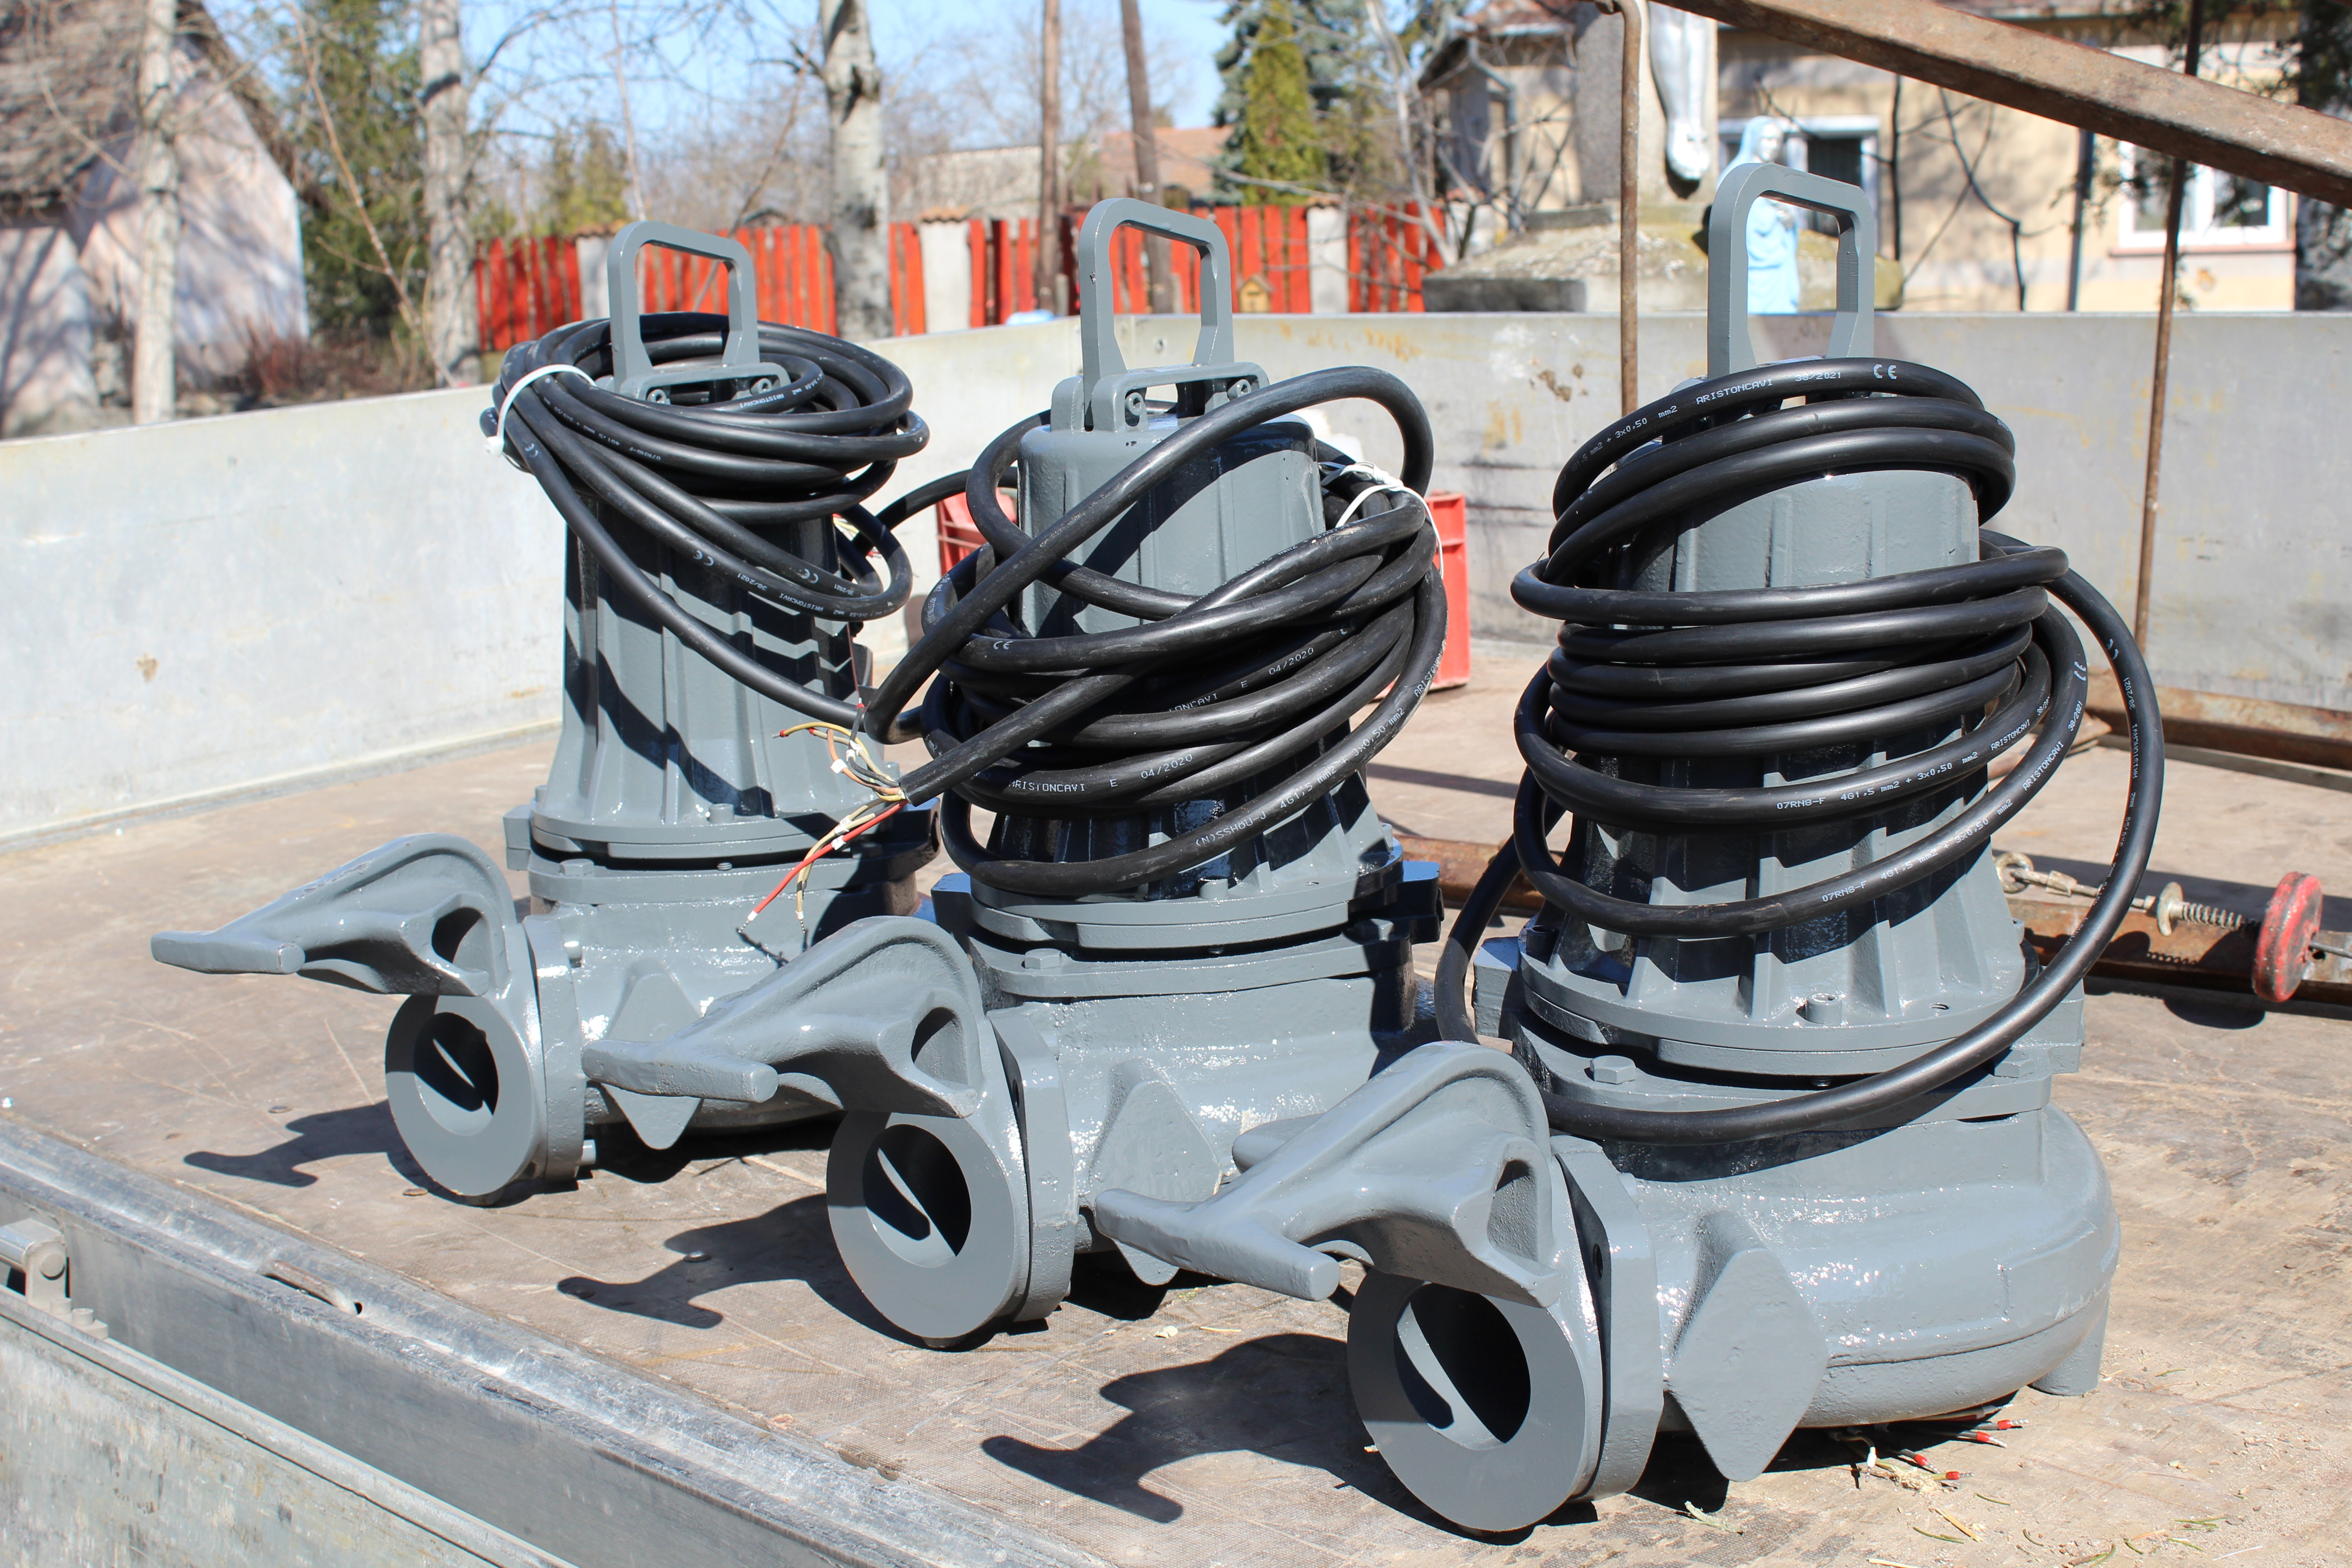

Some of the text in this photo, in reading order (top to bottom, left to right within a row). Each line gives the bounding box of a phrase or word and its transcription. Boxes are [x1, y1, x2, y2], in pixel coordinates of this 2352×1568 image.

[740, 393, 784, 408] ARISTONCAVI
[1590, 442, 1603, 455] mm2
[1615, 418, 1647, 438] 3x0,50
[1658, 405, 1678, 418] mm2
[1696, 378, 1773, 404] ARISTONCAVI
[1795, 371, 1841, 382] 38/2021
[1873, 364, 1897, 379] CE
[693, 550, 714, 566] CE
[737, 573, 768, 591] 38/2021
[779, 593, 823, 612] ARISTONCAVI
[993, 641, 1014, 650] CE
[1269, 647, 1314, 675] 04/2020
[2123, 677, 2135, 710] 38/2021
[1110, 779, 1118, 787] E
[1141, 754, 1193, 779] 04/2020
[1280, 782, 1313, 809] 4G1,5
[1317, 765, 1337, 784] mm2
[1388, 707, 1405, 725] mm2
[1777, 797, 1826, 809] 07RN8-F
[1841, 788, 1875, 800] 4G1,5
[1880, 781, 1900, 792] mm2
[1917, 763, 1952, 780] 3x0,50
[1962, 752, 1978, 764] mm2
[1991, 719, 2030, 750] ARISTONCAVI
[1822, 880, 1867, 902] 07RN8-F
[1919, 848, 1938, 864] mm2
[1955, 818, 1989, 844] 3x0,50
[1997, 799, 2014, 815] mm2
[2023, 741, 2064, 791] ARISTONCAVI
[2068, 701, 2083, 731] 38/2021
